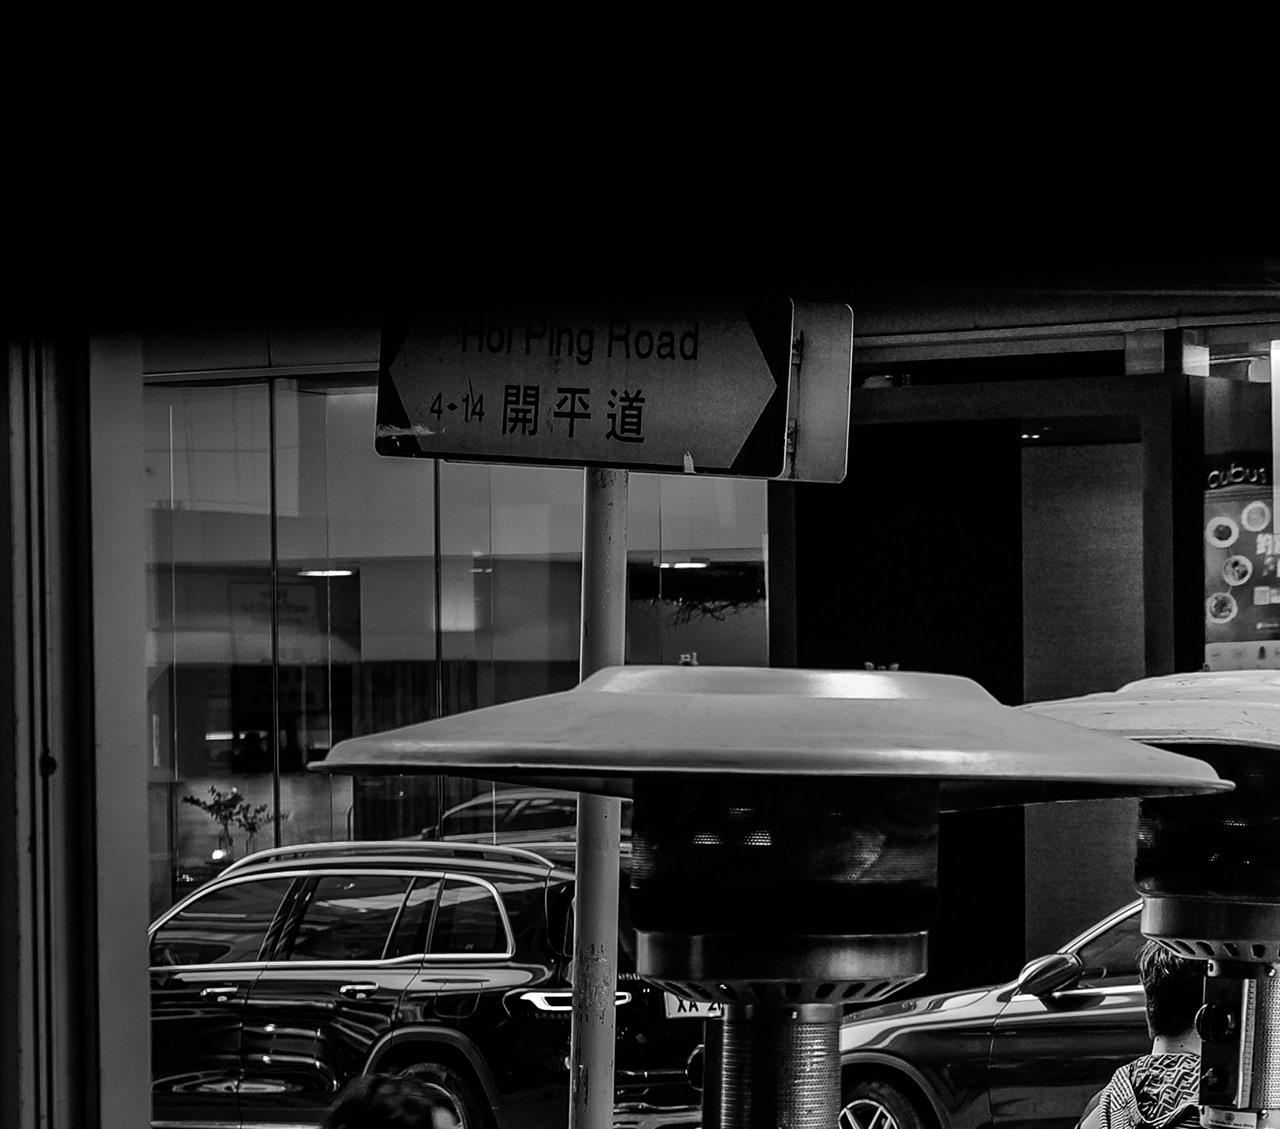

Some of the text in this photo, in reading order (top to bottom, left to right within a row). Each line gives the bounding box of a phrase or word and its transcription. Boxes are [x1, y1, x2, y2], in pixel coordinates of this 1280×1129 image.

[461, 315, 699, 365] Hoi Ping Road
[502, 384, 645, 444] 開平道
